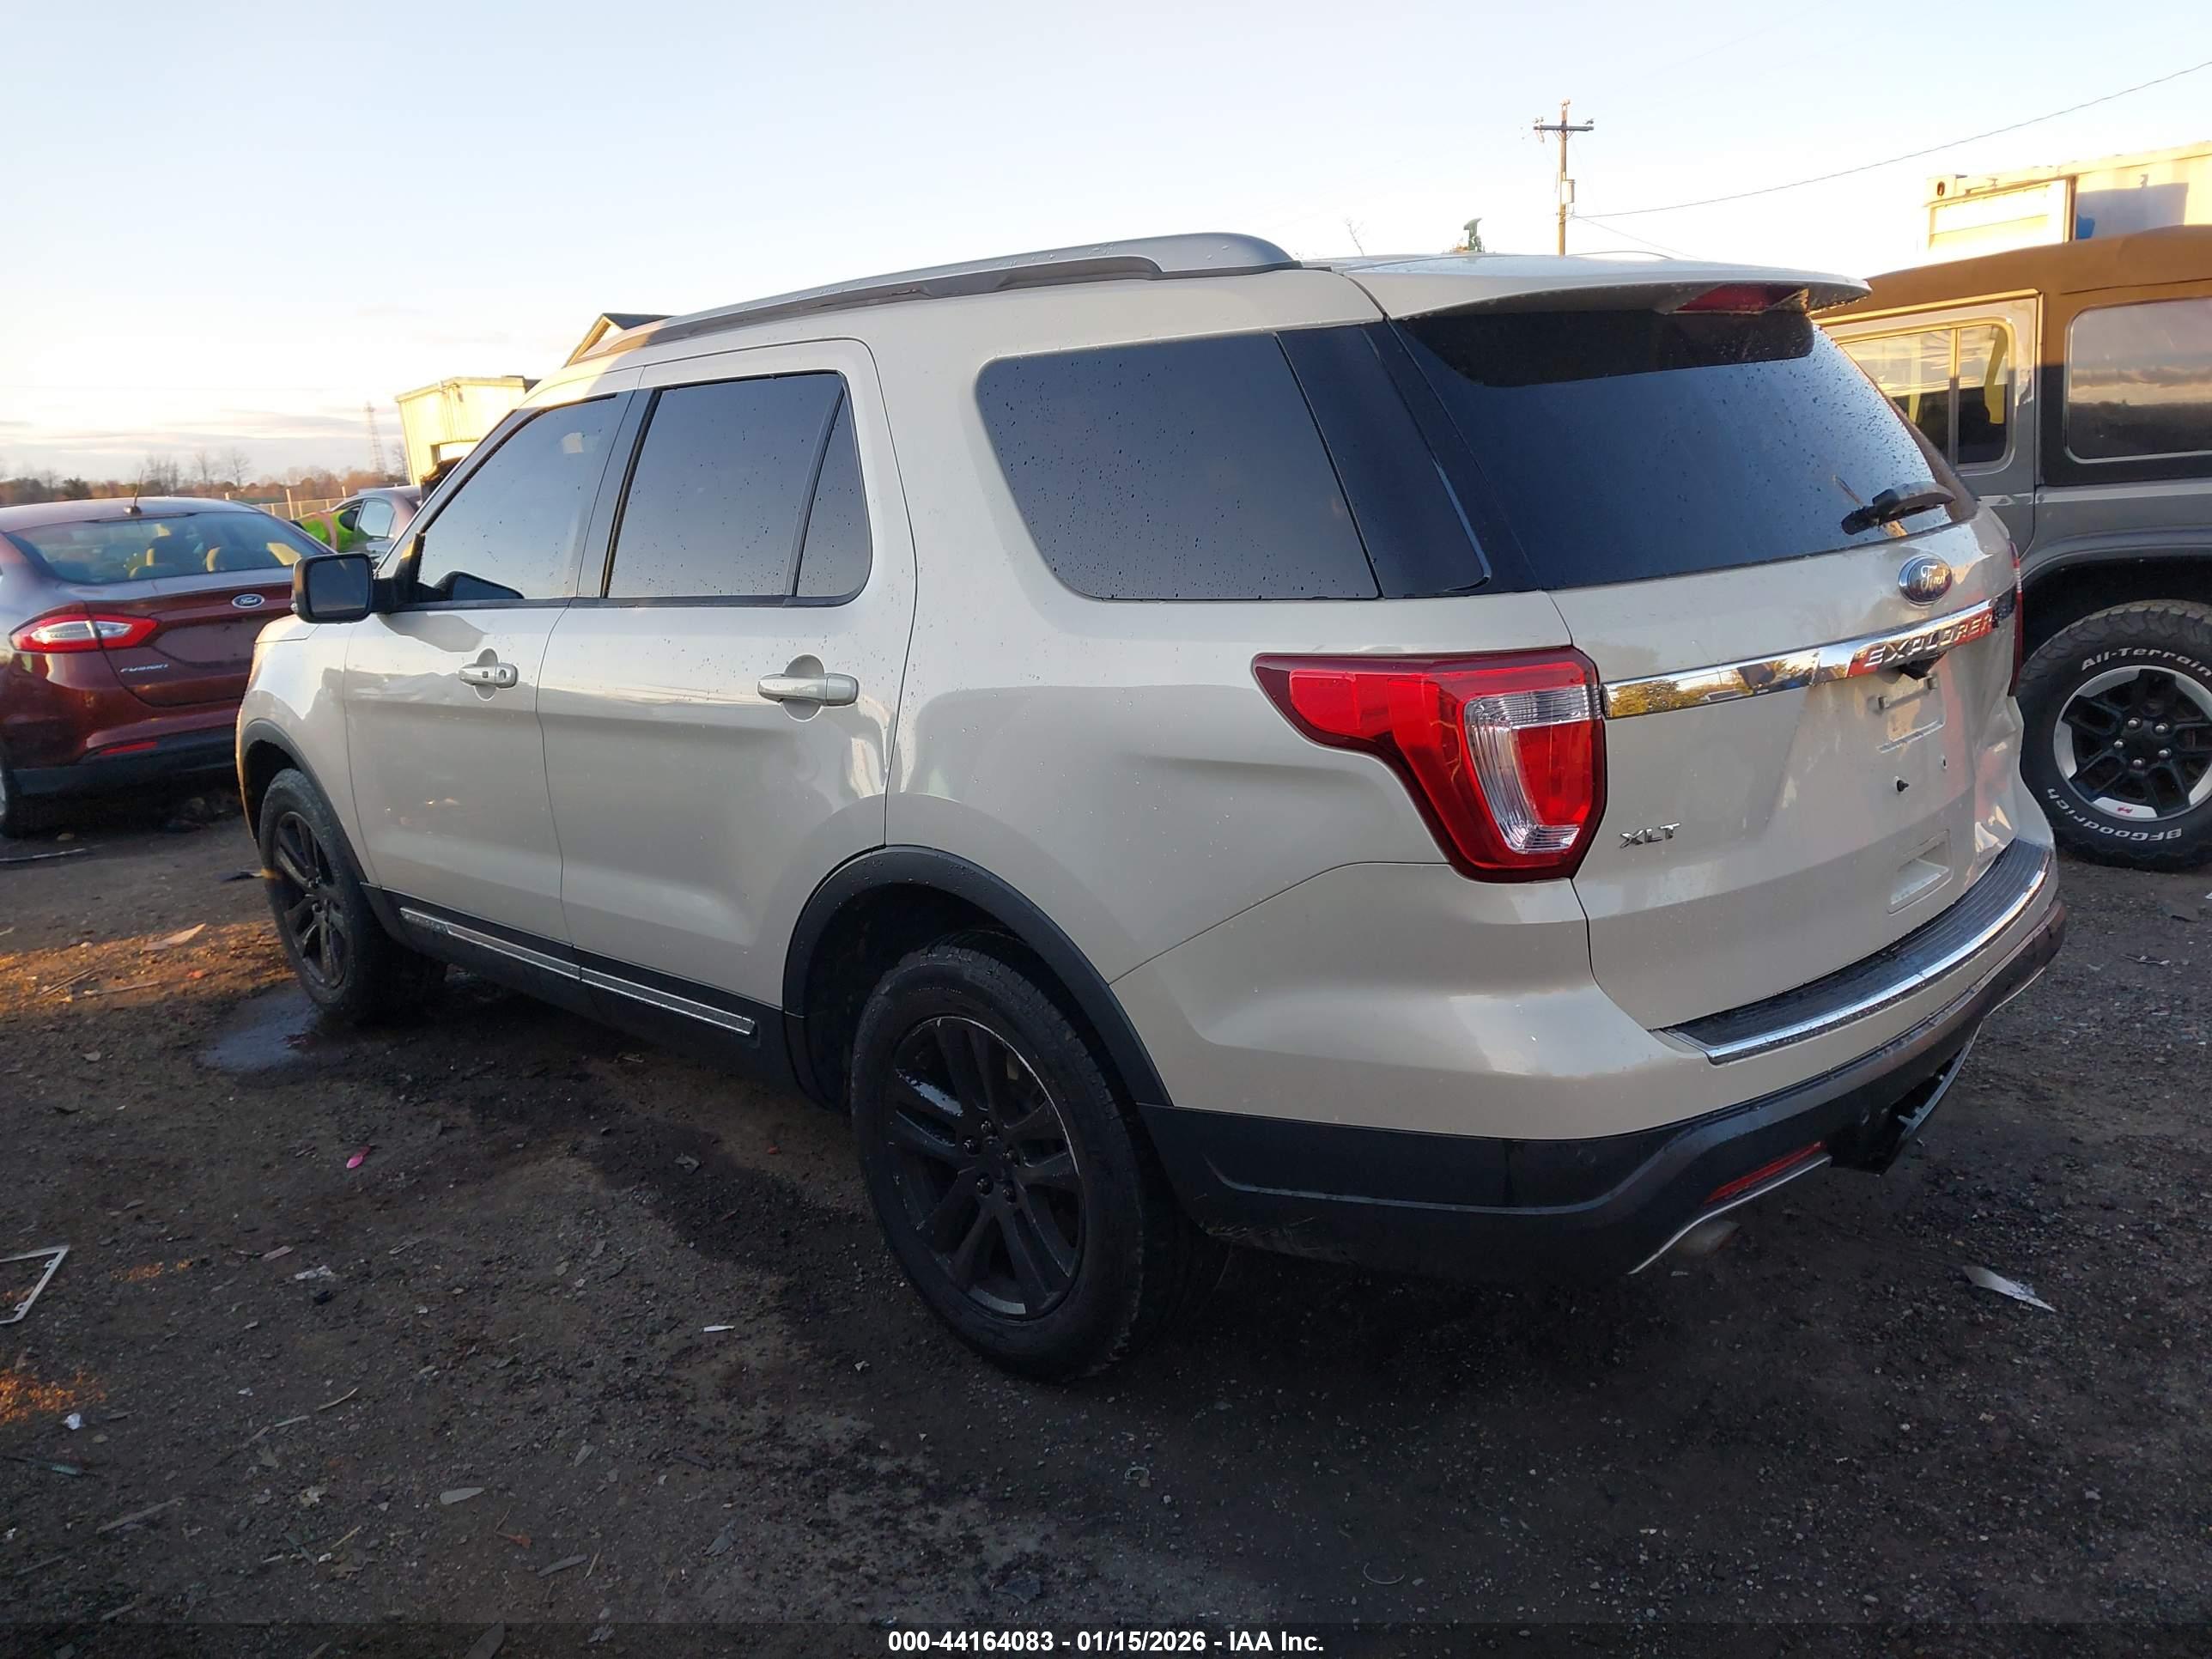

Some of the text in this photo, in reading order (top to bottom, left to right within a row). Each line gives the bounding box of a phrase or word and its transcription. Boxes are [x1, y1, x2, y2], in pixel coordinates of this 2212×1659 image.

[1920, 564, 1950, 592] Ford
[1864, 612, 1993, 667] EXPLORER
[2081, 647, 2212, 677] All-Terrain
[2047, 787, 2183, 842] BFGoodrich
[1620, 823, 1680, 848] XLT
